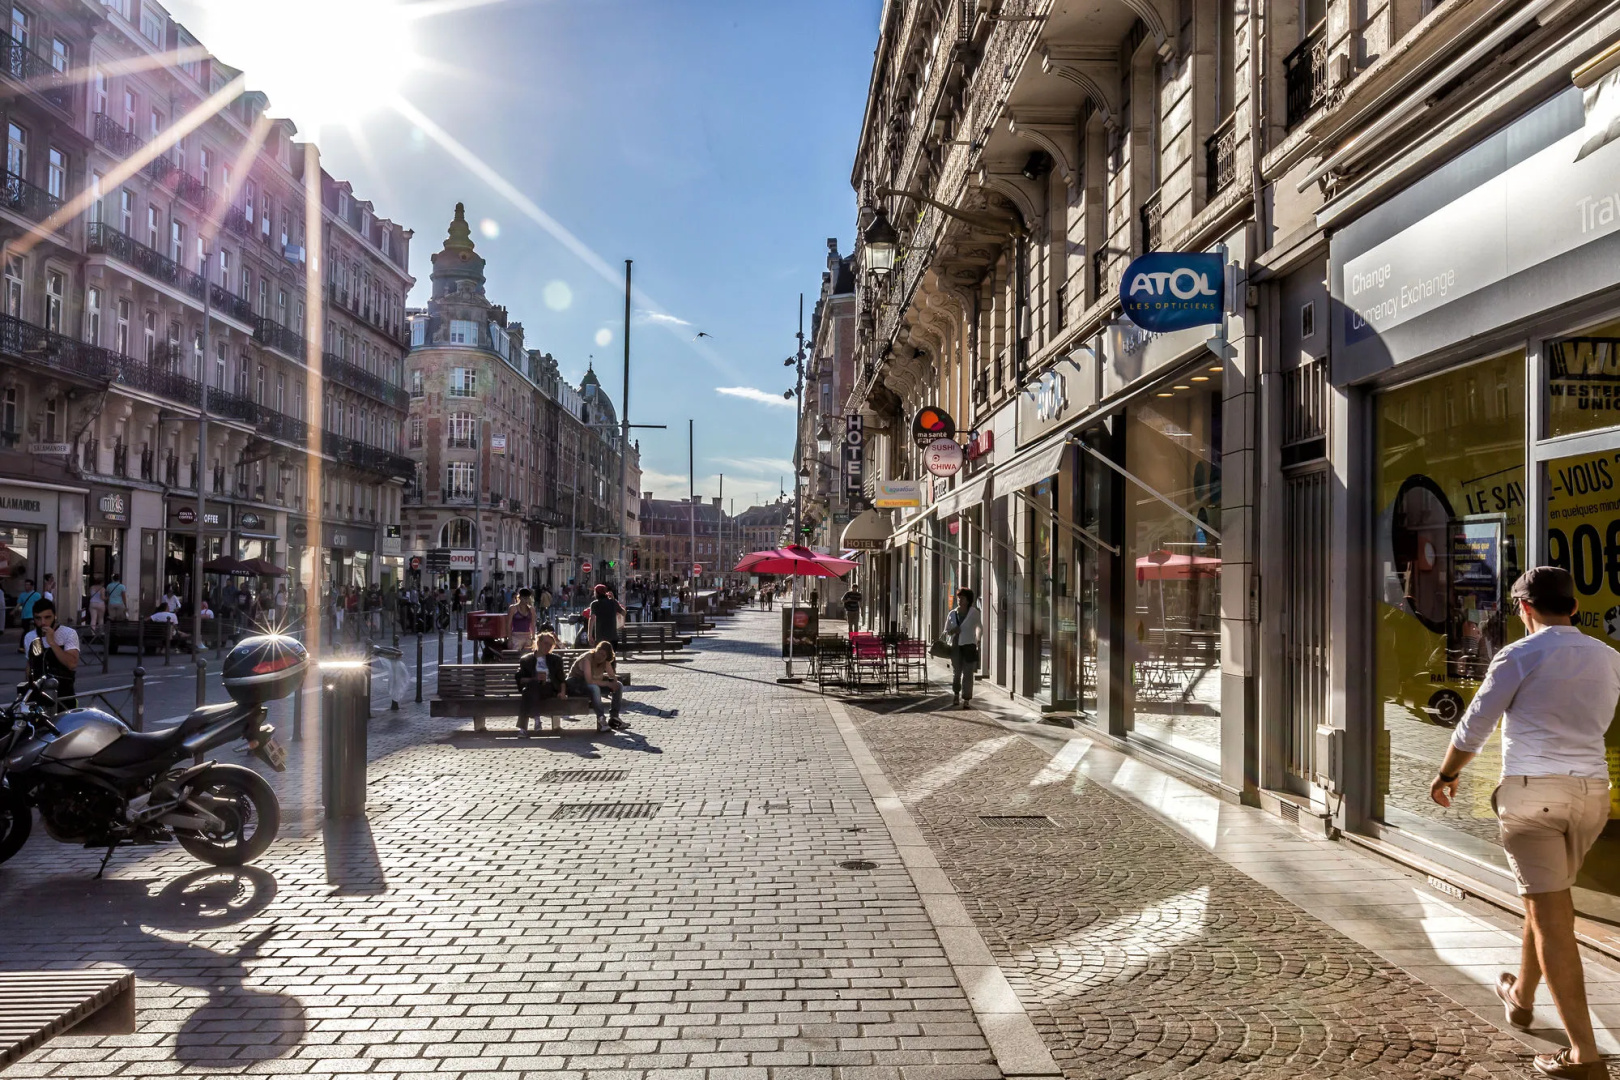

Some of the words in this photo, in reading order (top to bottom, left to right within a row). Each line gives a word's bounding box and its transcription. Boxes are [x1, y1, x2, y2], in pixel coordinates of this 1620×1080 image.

[1129, 268, 1217, 300] ATOL
[1352, 263, 1391, 296] Change
[1129, 302, 1150, 310] LES
[1155, 302, 1215, 310] OPTICIENS
[1352, 297, 1398, 330] Currency
[1401, 268, 1455, 309] Exchange
[33, 444, 67, 452] SALAMANDER
[847, 415, 861, 490] HOTEL
[1466, 490, 1489, 515] LE
[1550, 510, 1561, 519] en
[1562, 504, 1599, 519] quelques
[1599, 498, 1620, 513] minu
[846, 540, 876, 548] HOTEL
[450, 555, 476, 564] onop
